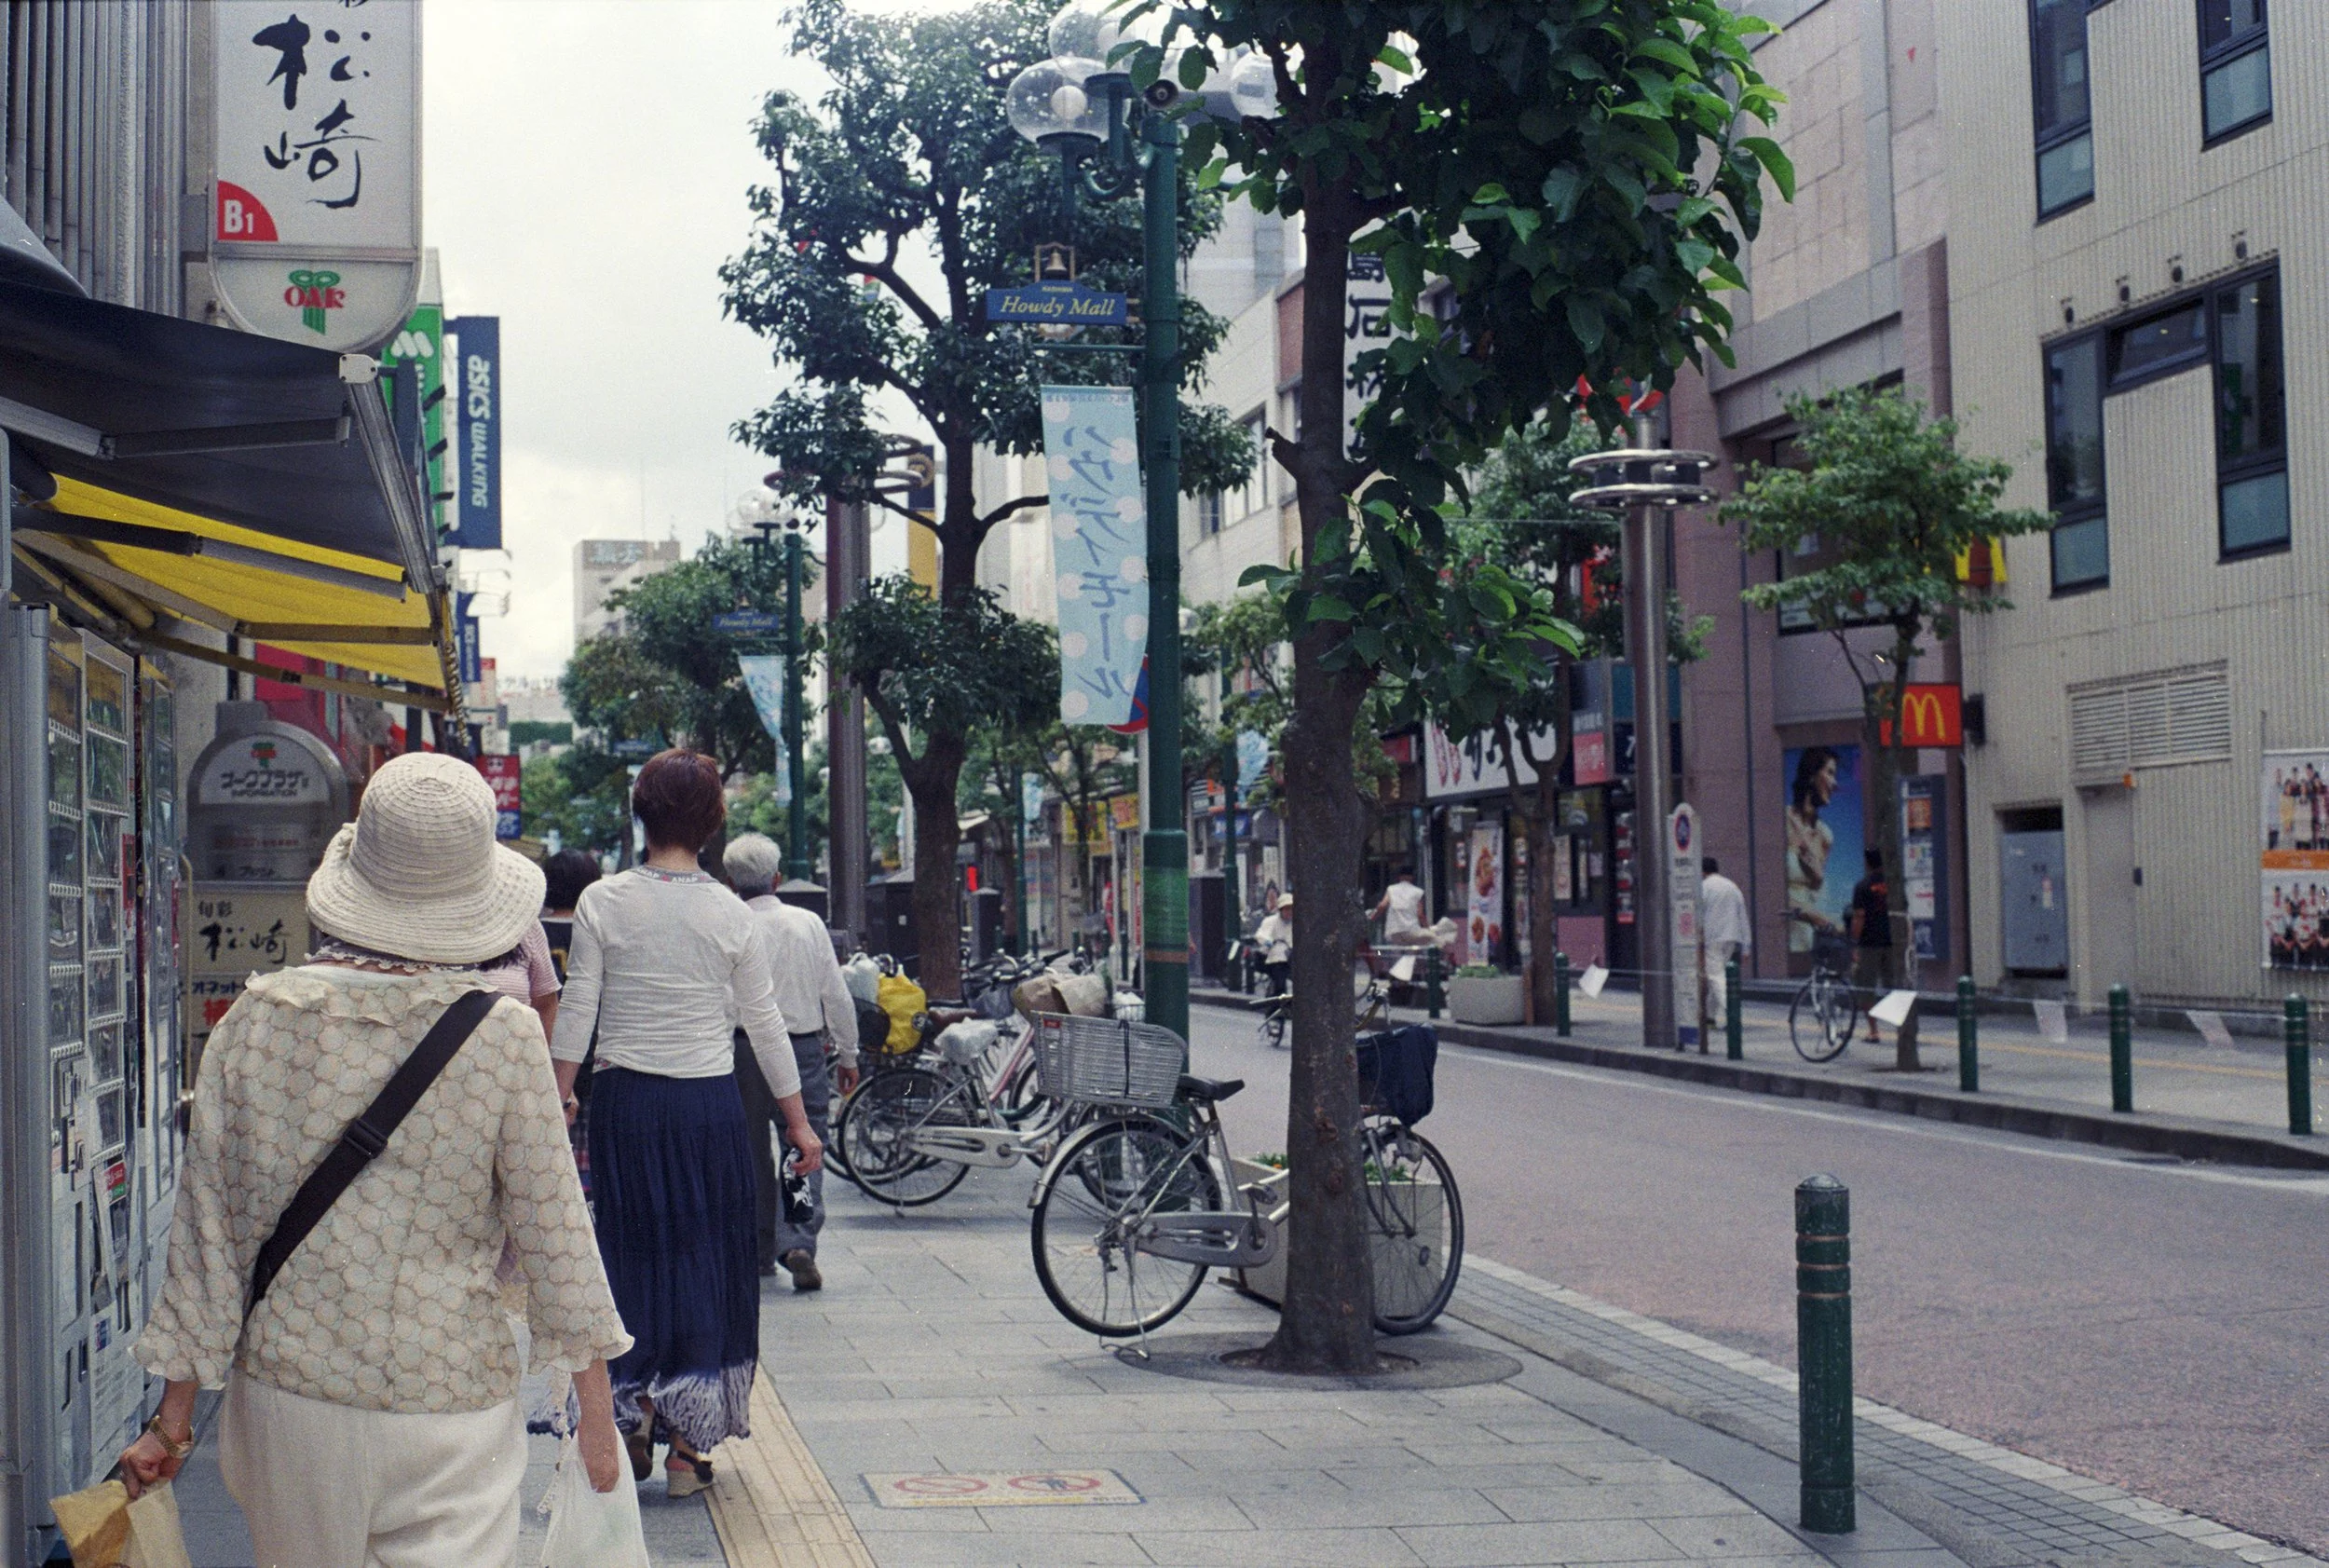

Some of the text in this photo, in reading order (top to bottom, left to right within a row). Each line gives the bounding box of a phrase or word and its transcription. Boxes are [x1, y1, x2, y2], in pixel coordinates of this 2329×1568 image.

[252, 13, 381, 210] 松崎
[224, 199, 253, 234] B1
[283, 285, 346, 309] OAK
[1001, 295, 1116, 318] Howdy Mall
[198, 918, 291, 964] 松崎
